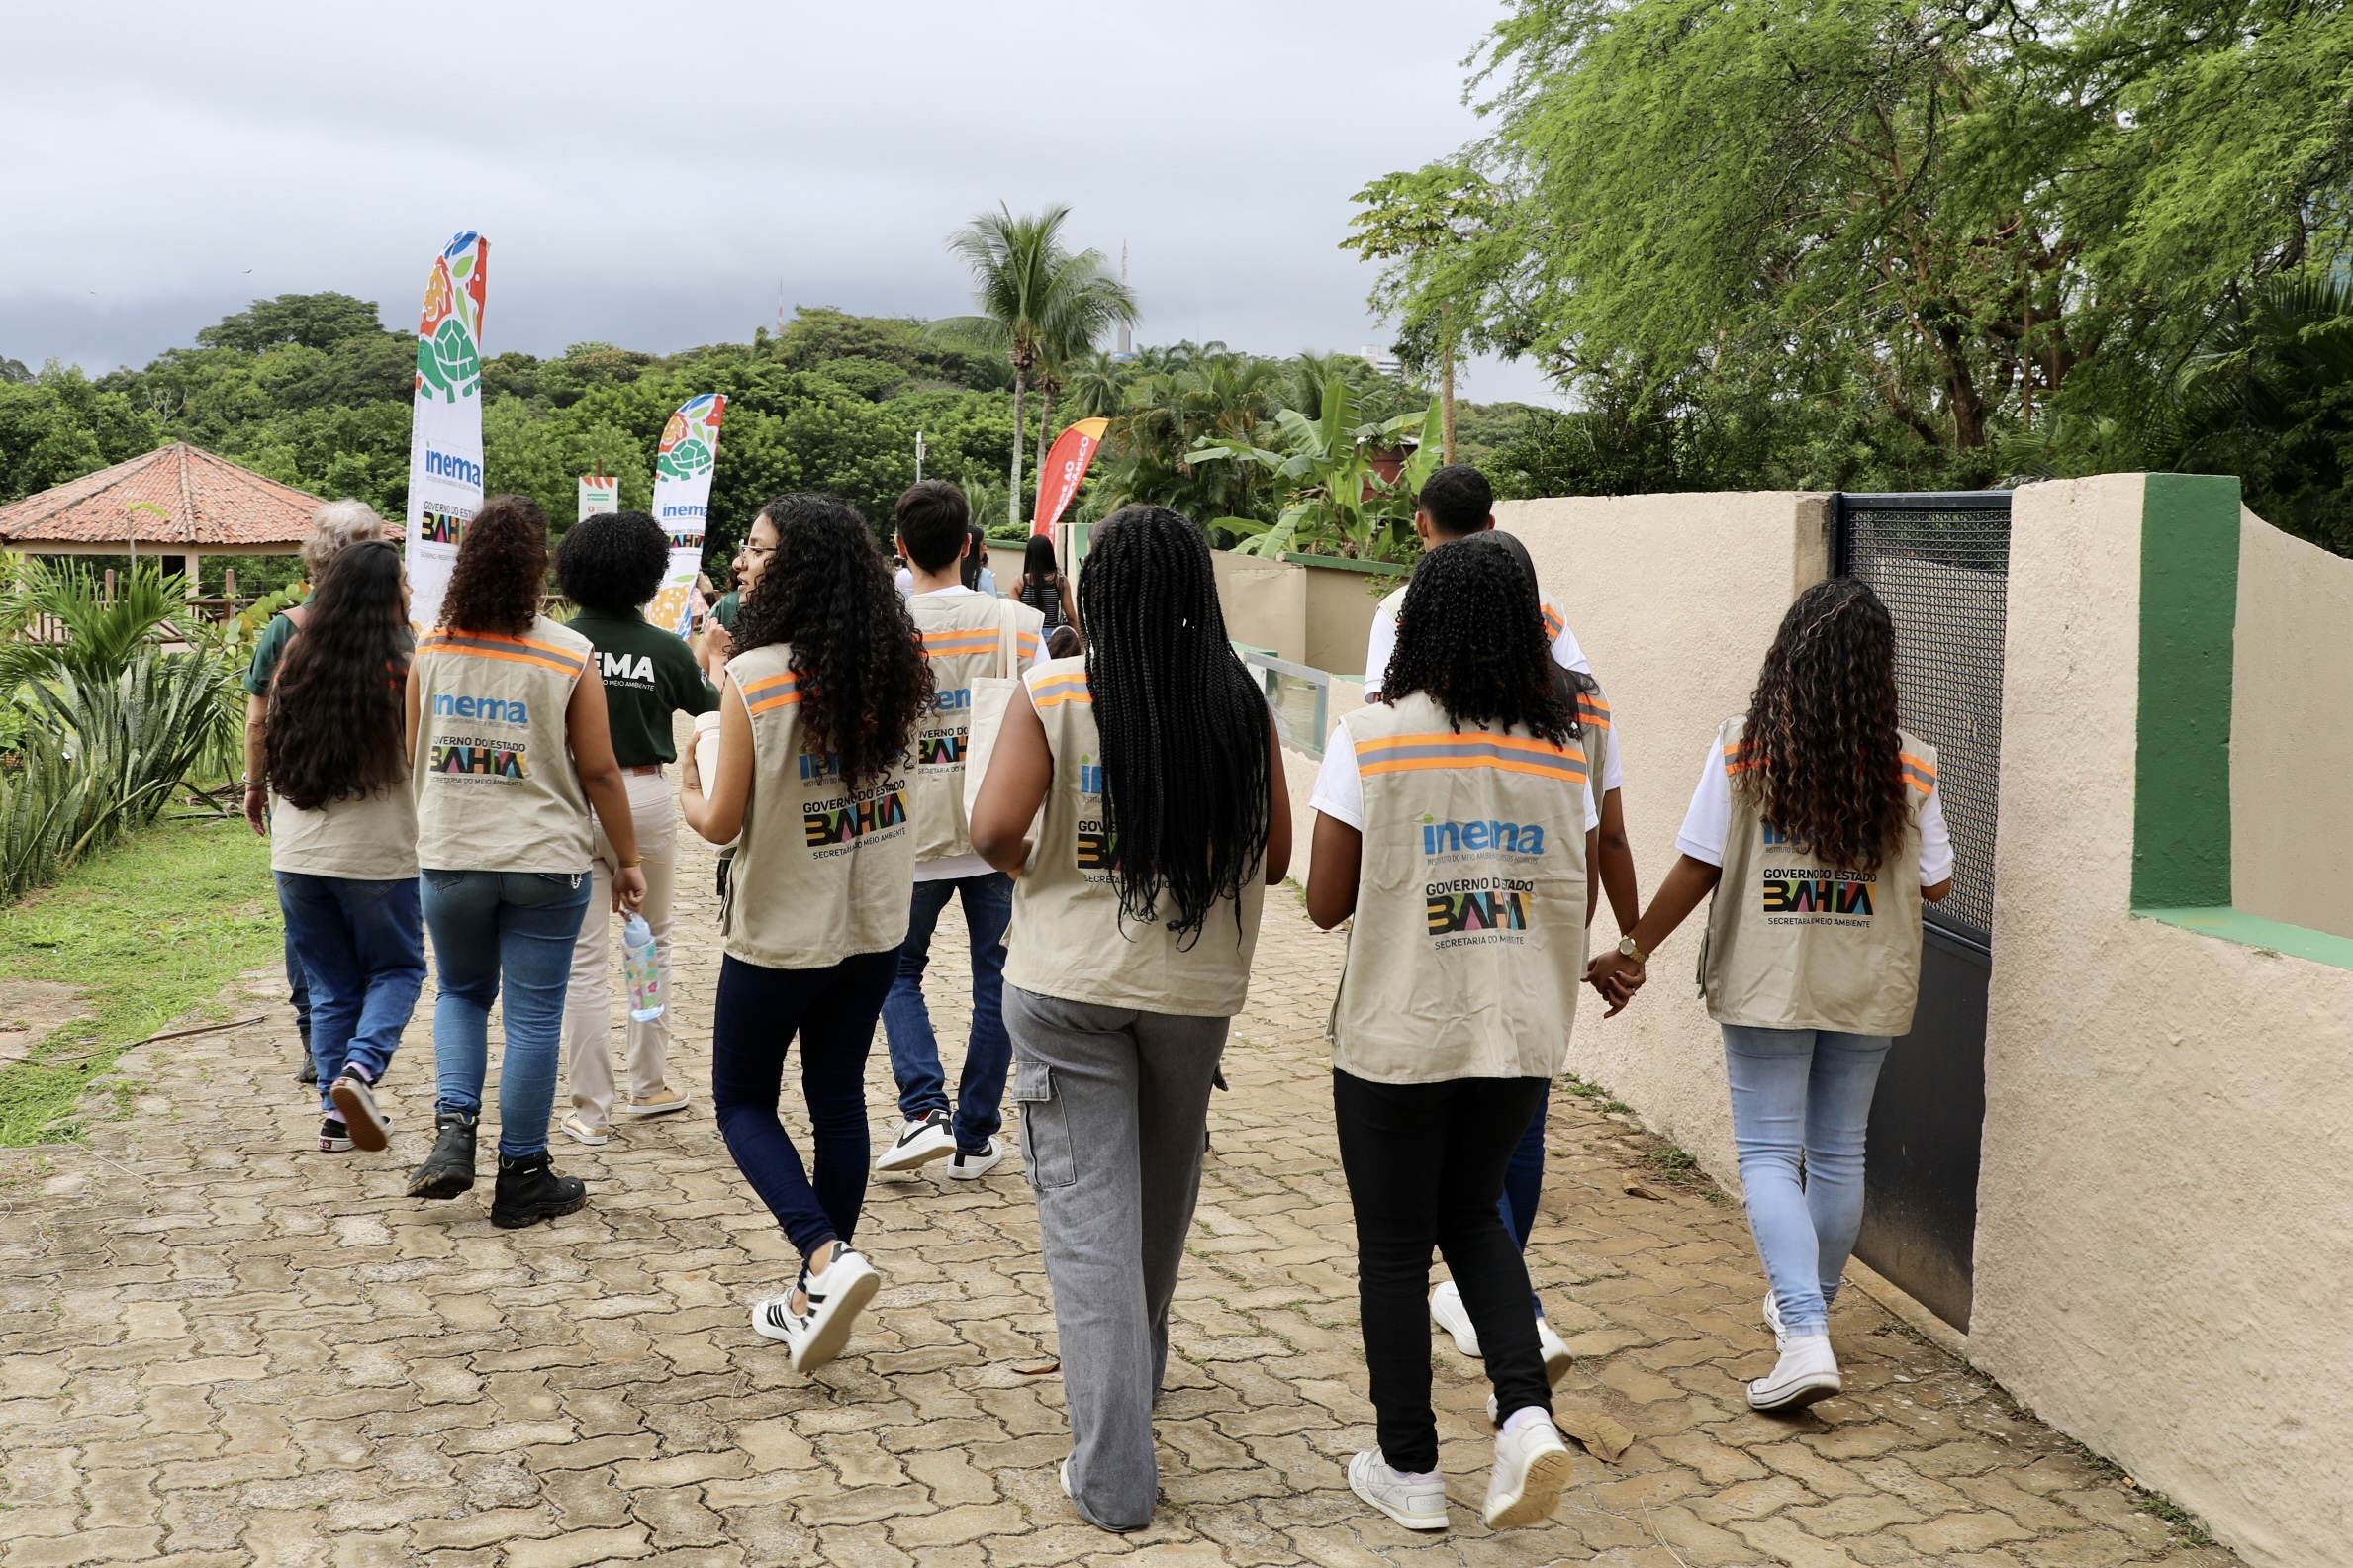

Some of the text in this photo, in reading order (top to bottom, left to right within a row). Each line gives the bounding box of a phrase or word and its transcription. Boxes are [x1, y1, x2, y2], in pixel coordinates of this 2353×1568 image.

[425, 441, 481, 487] inema
[424, 500, 475, 519] GOVERNO DO EST
[421, 511, 473, 546] BAH
[594, 652, 655, 683] EMA
[624, 681, 655, 692] AMBIENTE
[919, 727, 955, 739] VERNO
[475, 737, 488, 748] DO
[490, 740, 526, 752] ESTADO
[918, 735, 969, 765] BAH
[429, 745, 525, 780] BAHIA
[858, 789, 874, 802] DO
[803, 793, 907, 848] BAHIA
[863, 836, 880, 847] MEIO
[880, 827, 906, 842] AMBIENTE
[1765, 846, 1792, 855] INSTITUTO
[1763, 869, 1819, 879] GOVERNO
[1835, 870, 1877, 883] ESTADO
[1426, 877, 1489, 896] GOVERNO
[1763, 880, 1874, 916] BAHIA
[1834, 918, 1871, 928] AMBIENTE
[1434, 937, 1486, 951] SECRETARIA
[1488, 935, 1497, 944] DO
